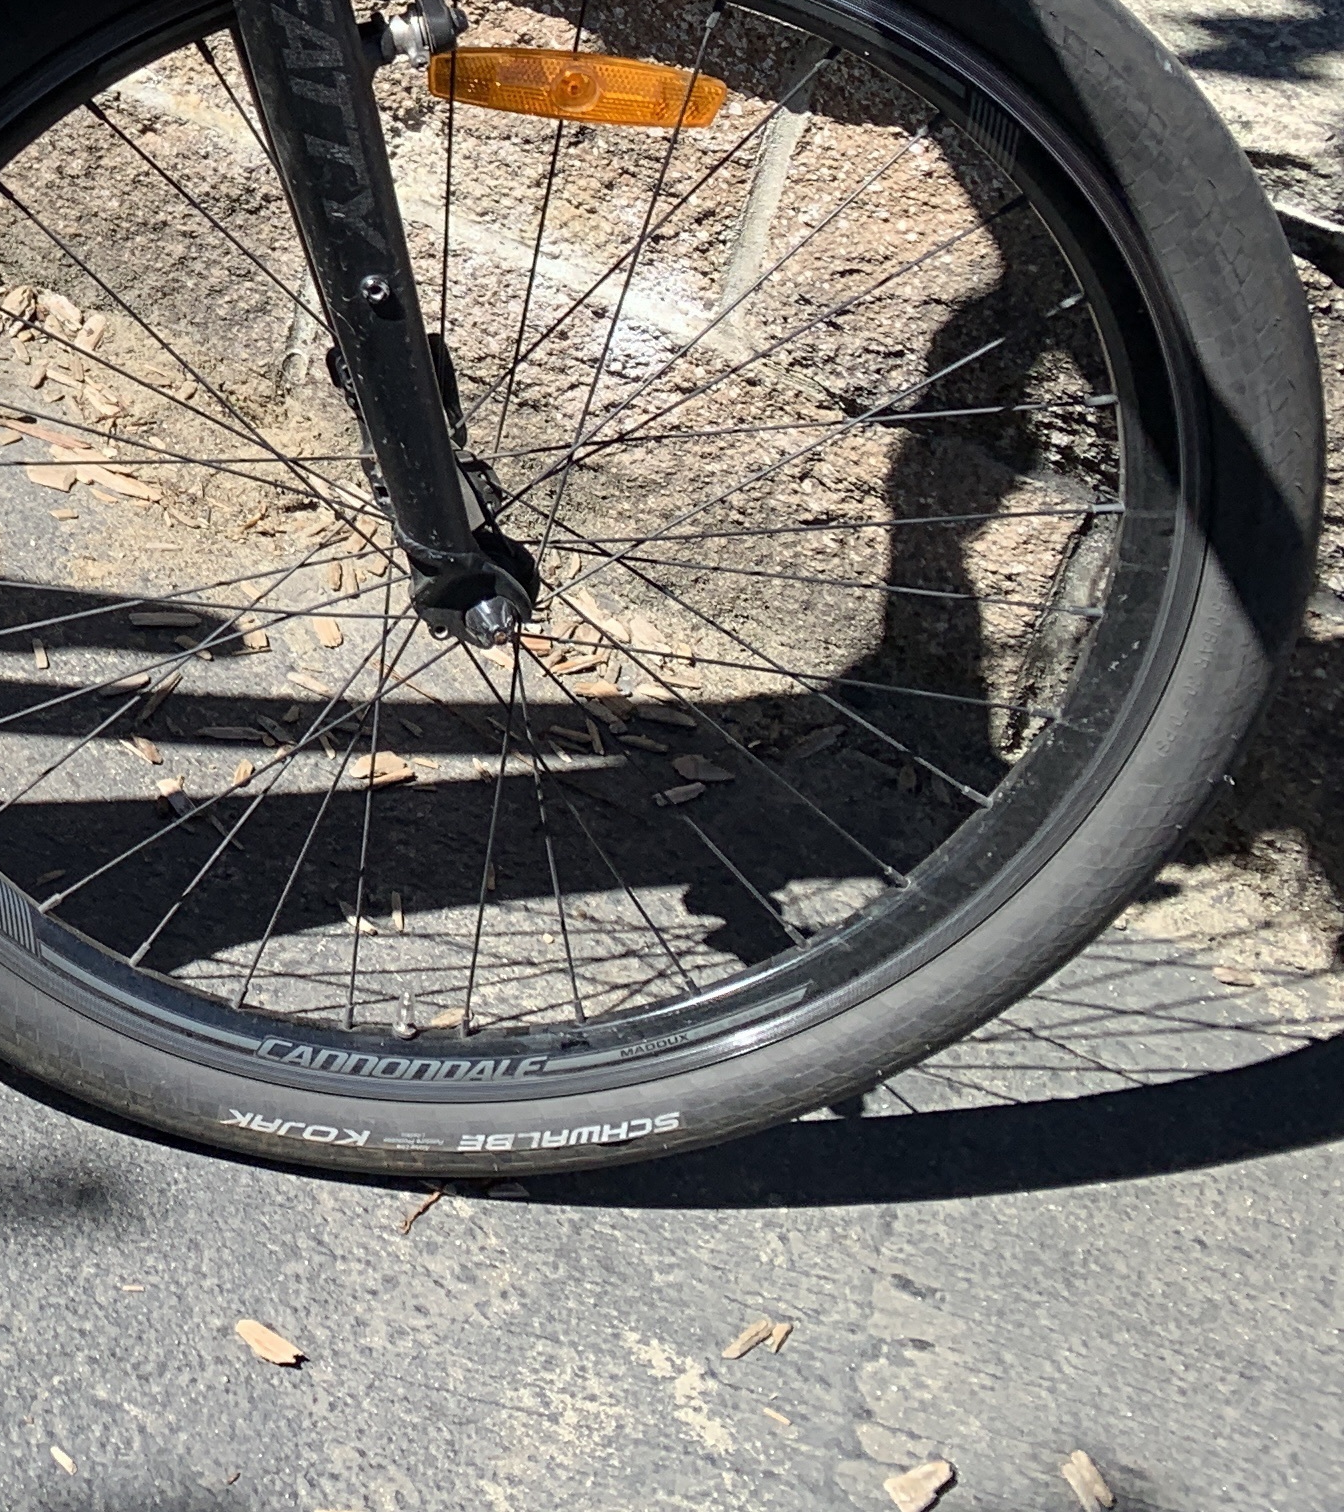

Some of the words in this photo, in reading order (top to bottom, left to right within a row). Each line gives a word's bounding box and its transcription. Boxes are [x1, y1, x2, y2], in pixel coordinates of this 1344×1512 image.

[257, 1038, 549, 1081] CANNONDALE
[619, 1032, 690, 1058] MADDUX
[219, 1108, 372, 1148] KOJAK
[457, 1111, 681, 1152] SCHWALBE
